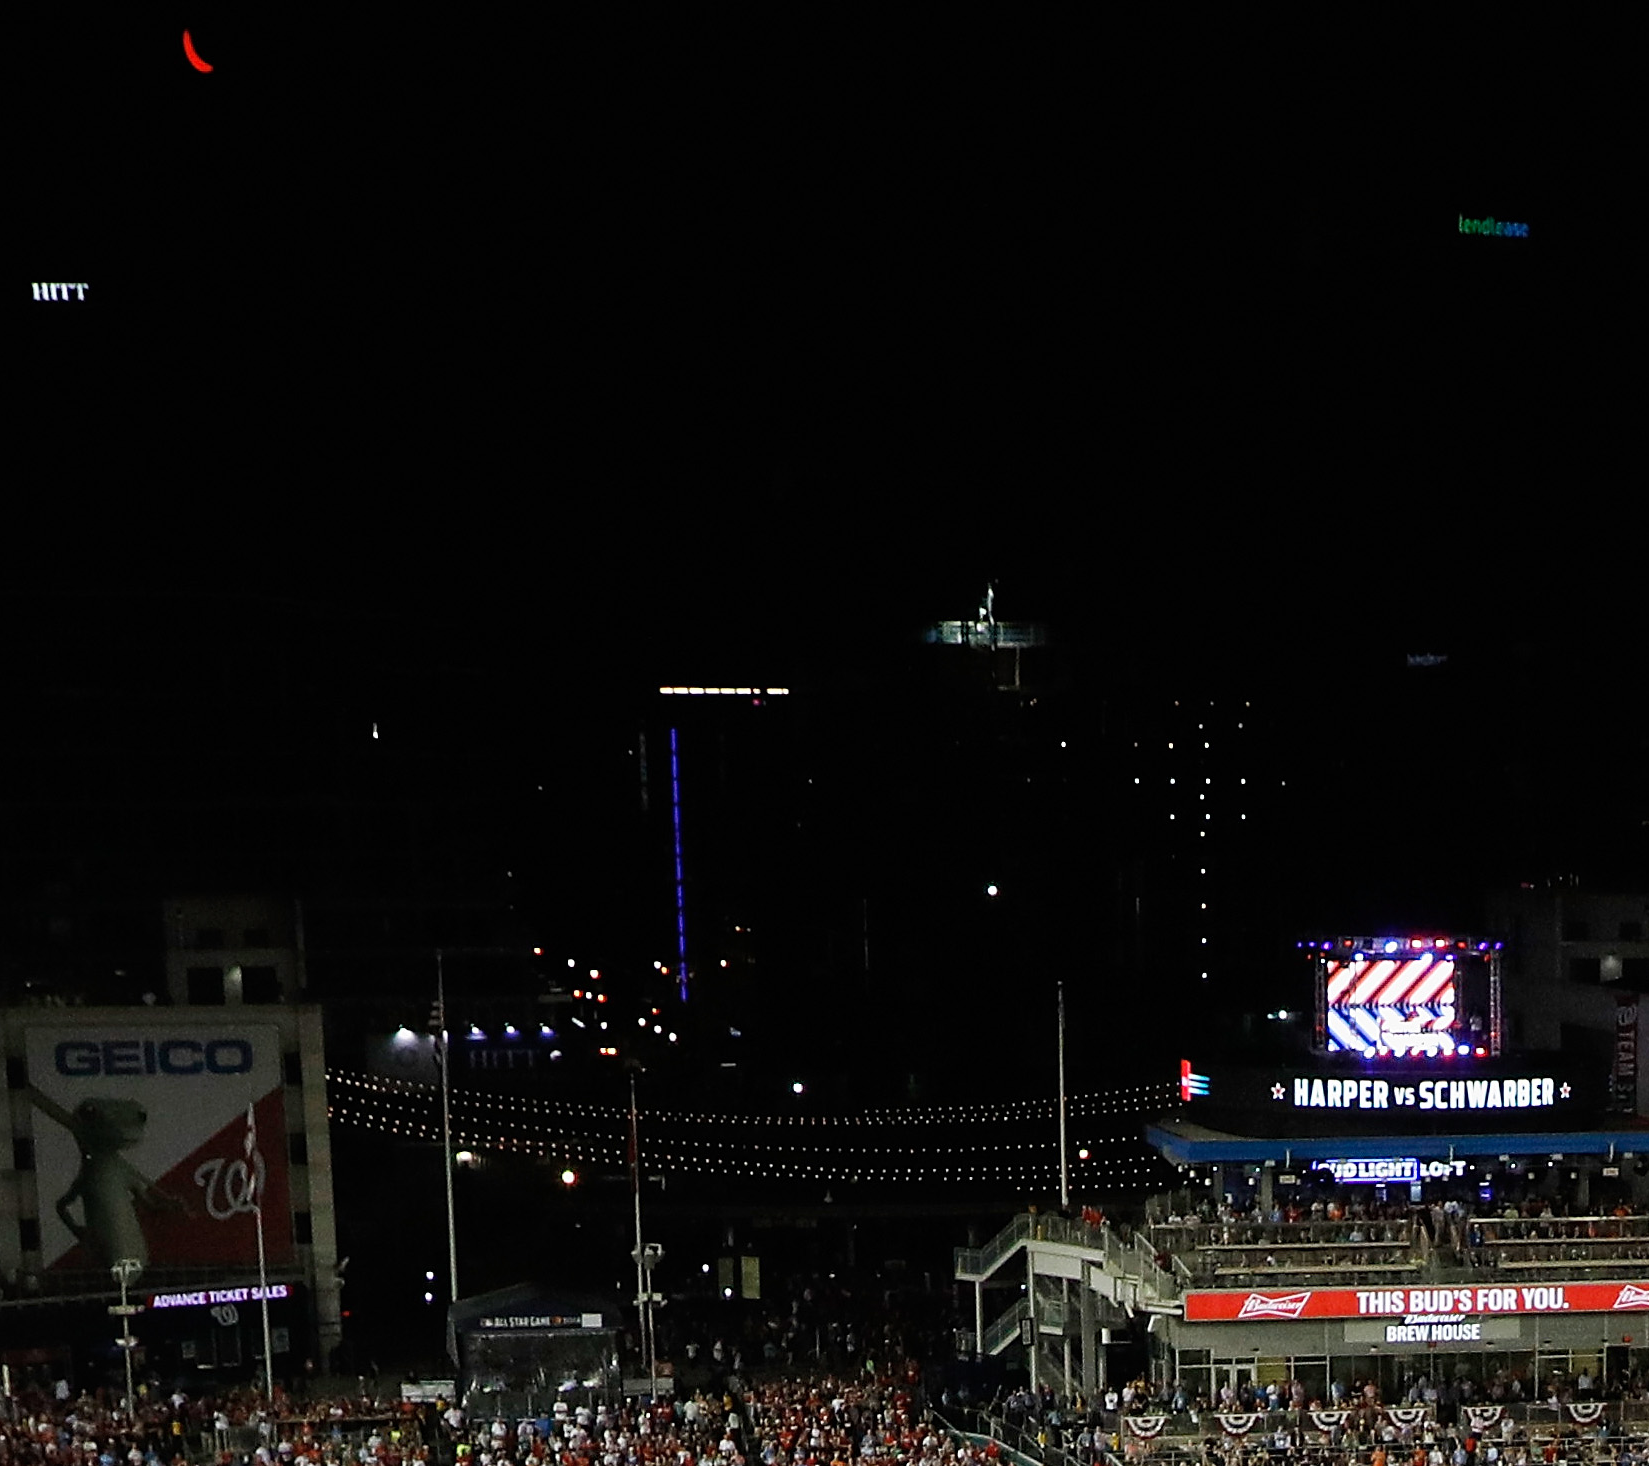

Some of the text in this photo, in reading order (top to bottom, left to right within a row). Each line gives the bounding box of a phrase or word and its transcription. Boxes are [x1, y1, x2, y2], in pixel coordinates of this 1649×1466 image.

[31, 282, 90, 301] HITT
[54, 1039, 253, 1077] GEICO
[1293, 1077, 1555, 1110] HARPER SCHWARBER
[1358, 1159, 1467, 1178] LIGHT LOFT
[151, 1287, 249, 1309] ADVANCE TICKET
[1355, 1287, 1570, 1314] THIS BUD'S FOR YOU.
[1385, 1323, 1482, 1343] BREW HOUSE
